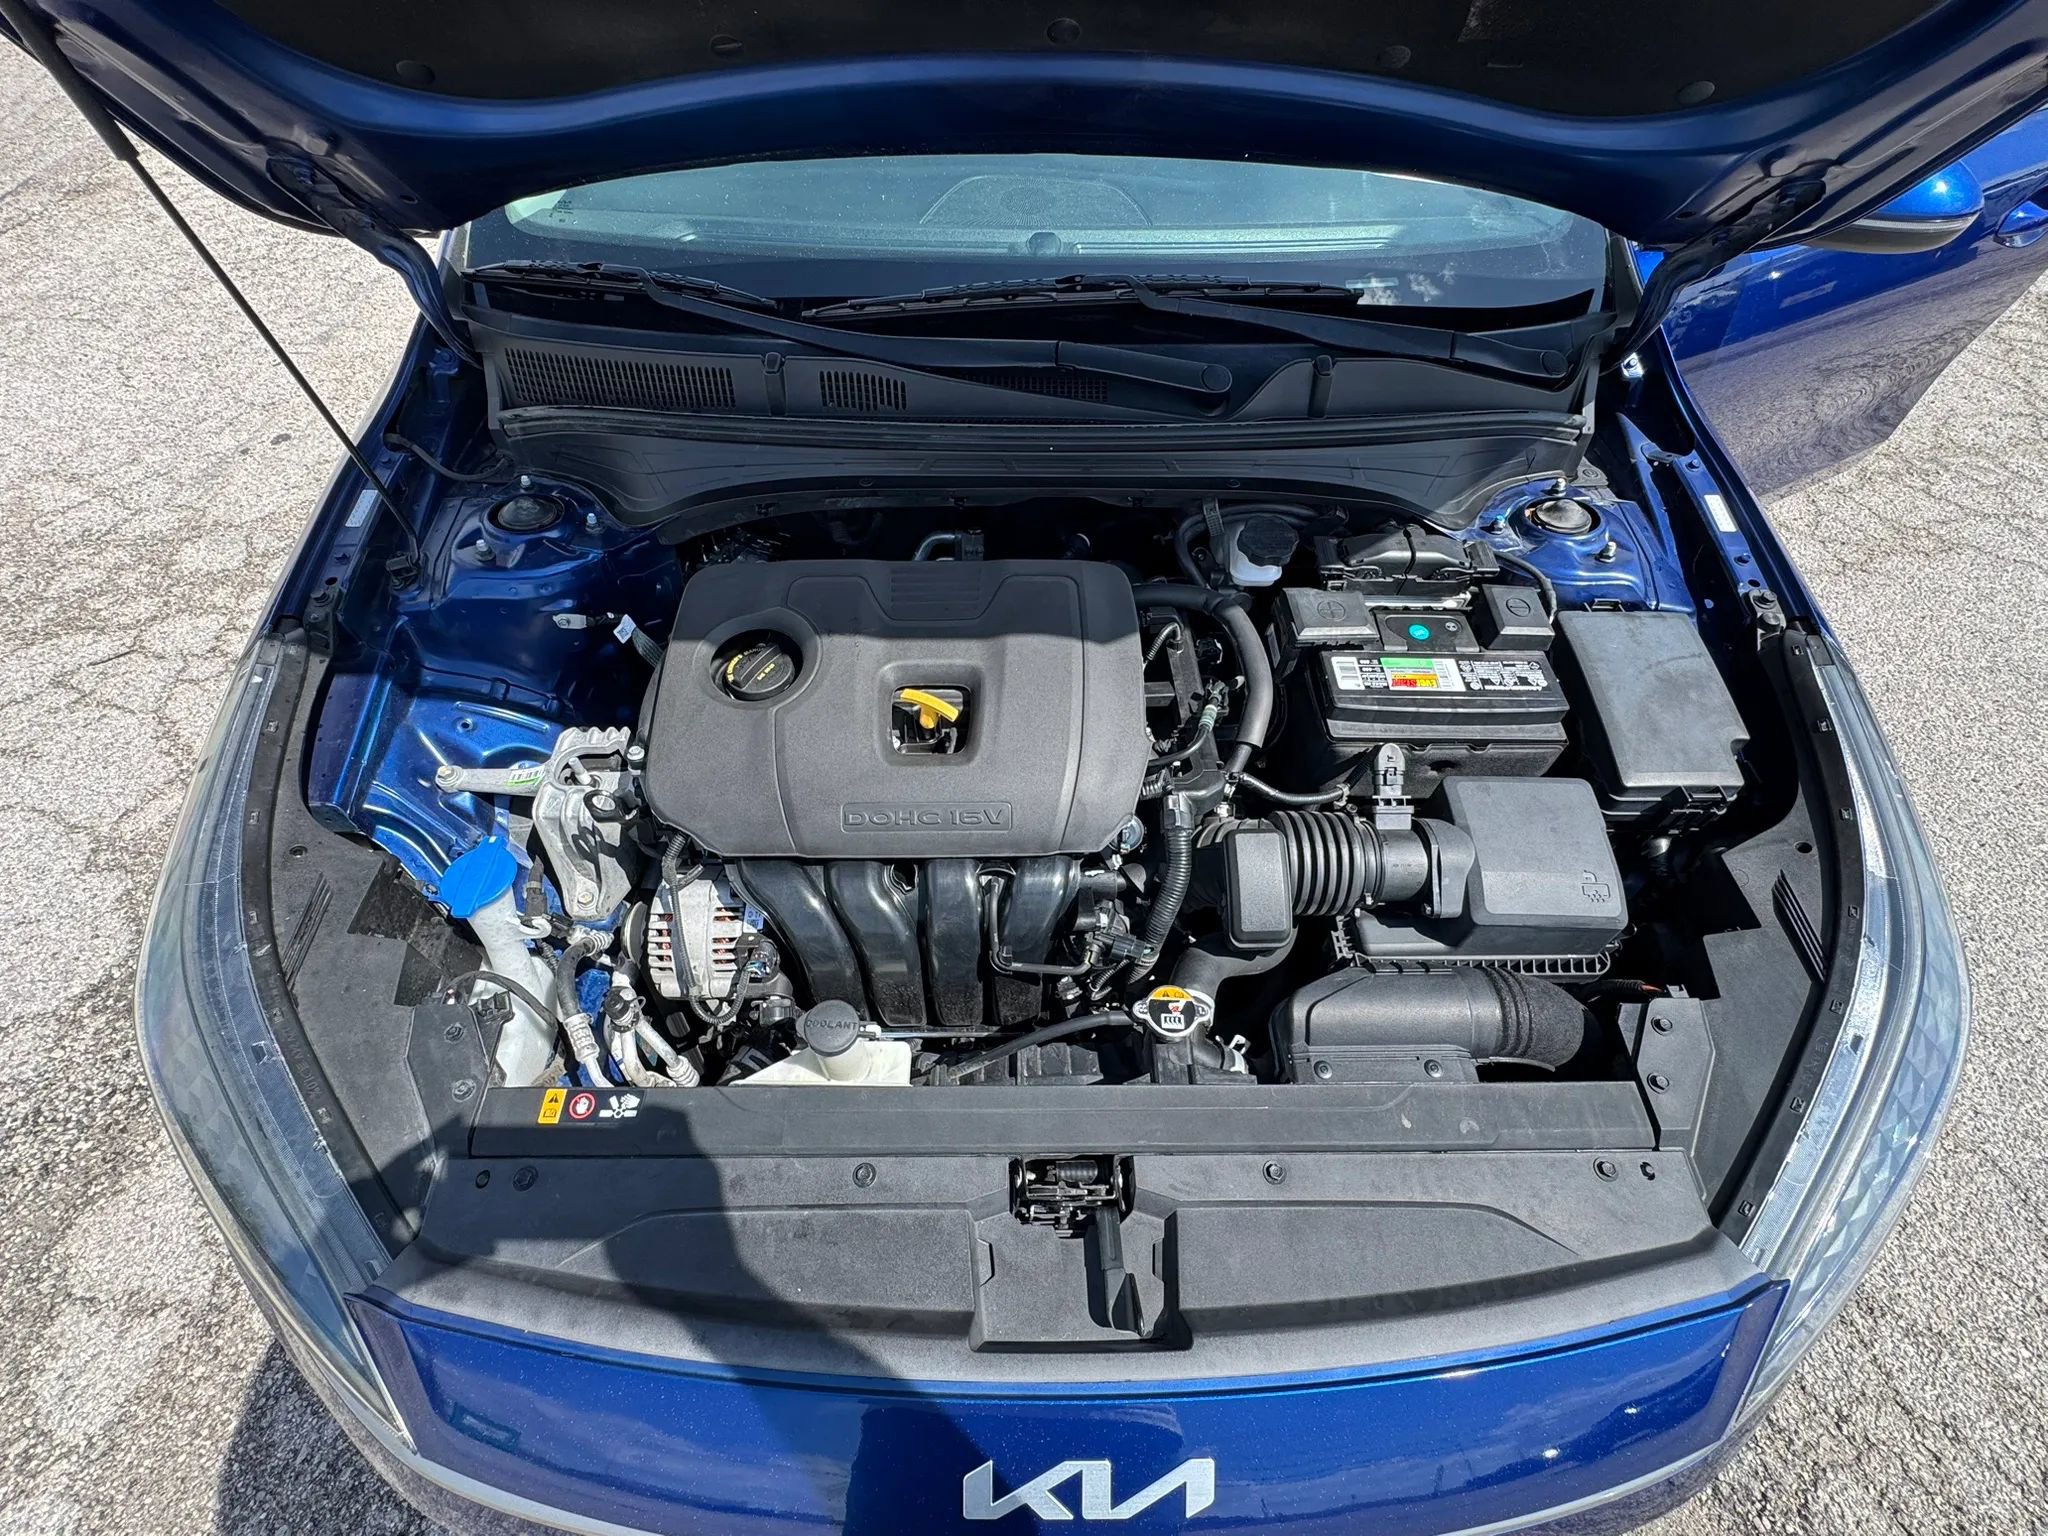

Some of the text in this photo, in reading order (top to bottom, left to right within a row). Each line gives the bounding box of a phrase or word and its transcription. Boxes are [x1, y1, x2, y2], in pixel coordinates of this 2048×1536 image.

[844, 809, 1003, 826] DOHC 16V
[806, 1018, 859, 1031] COOLANT
[963, 1458, 1216, 1520] KIA
